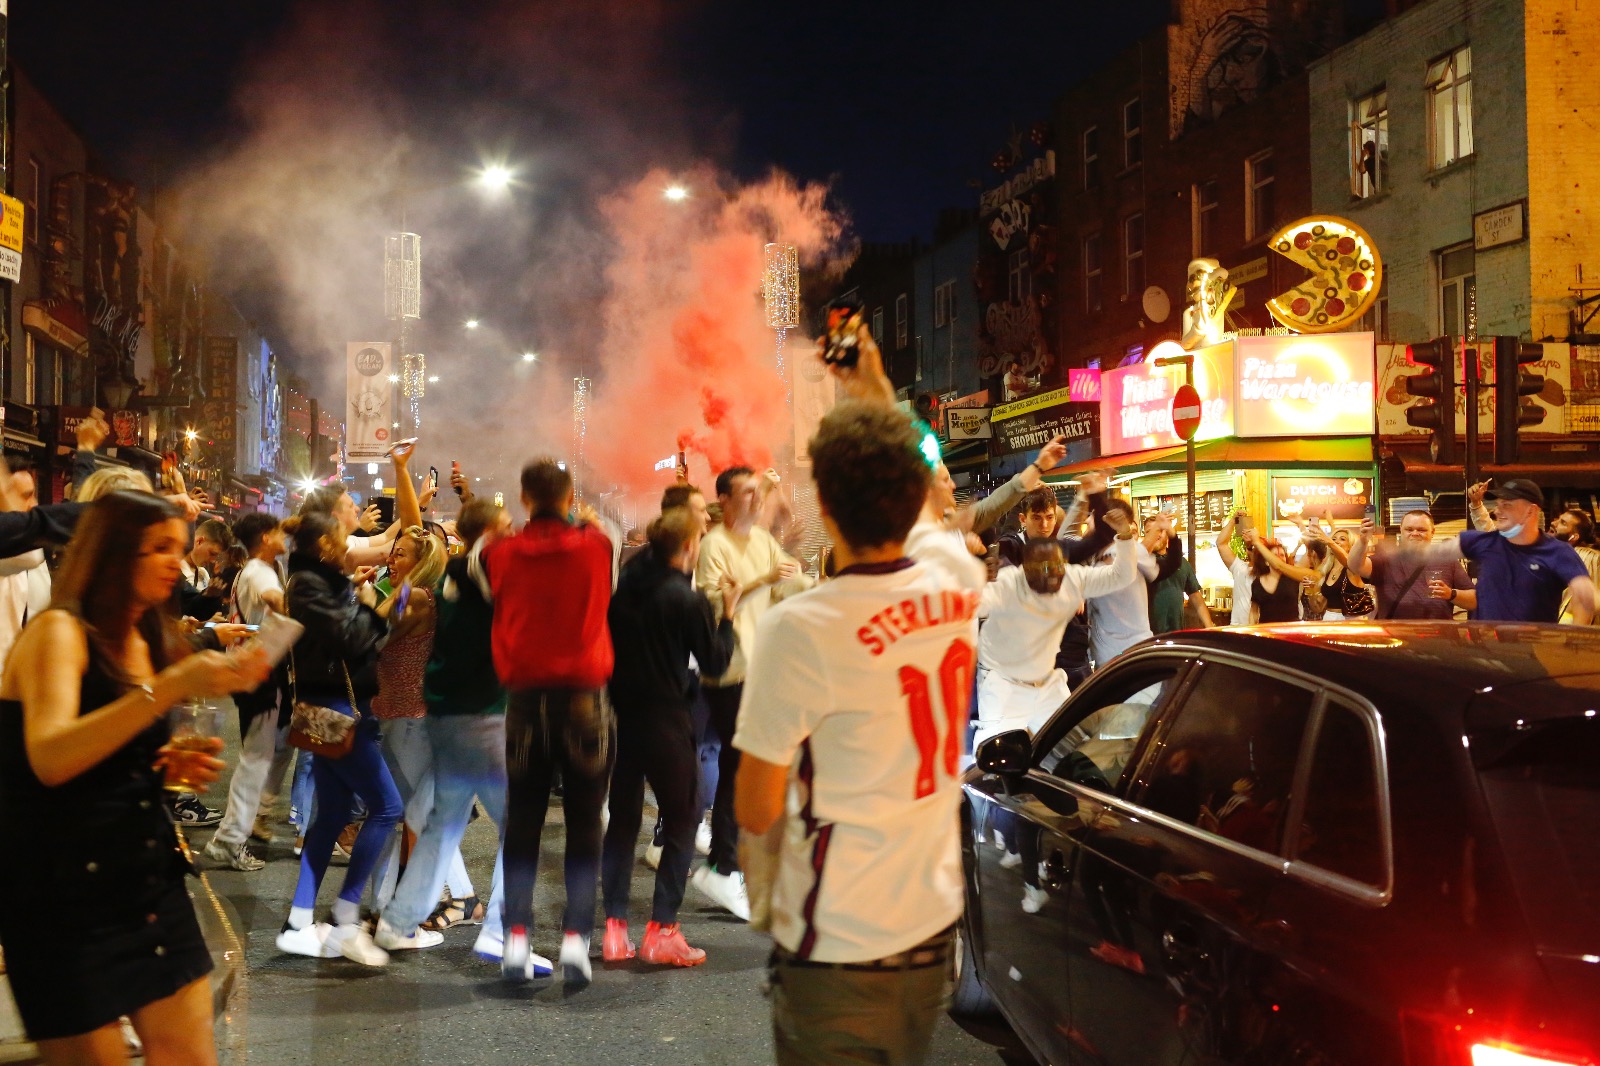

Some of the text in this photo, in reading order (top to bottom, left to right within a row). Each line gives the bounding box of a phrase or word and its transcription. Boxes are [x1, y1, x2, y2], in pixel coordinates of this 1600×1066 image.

[9, 217, 19, 230] Zone
[1484, 215, 1513, 232] CAMDEN
[1491, 230, 1500, 242] ST
[1244, 357, 1297, 379] Pizza
[1071, 373, 1100, 398] illy
[1240, 376, 1373, 403] Warehouse
[951, 414, 991, 429] Martens
[1009, 429, 1050, 450] SHOPRITE
[1052, 420, 1092, 439] MARKET
[1290, 485, 1337, 496] DUTCH
[1307, 495, 1367, 505] PANCAKES
[897, 637, 978, 801] 10
